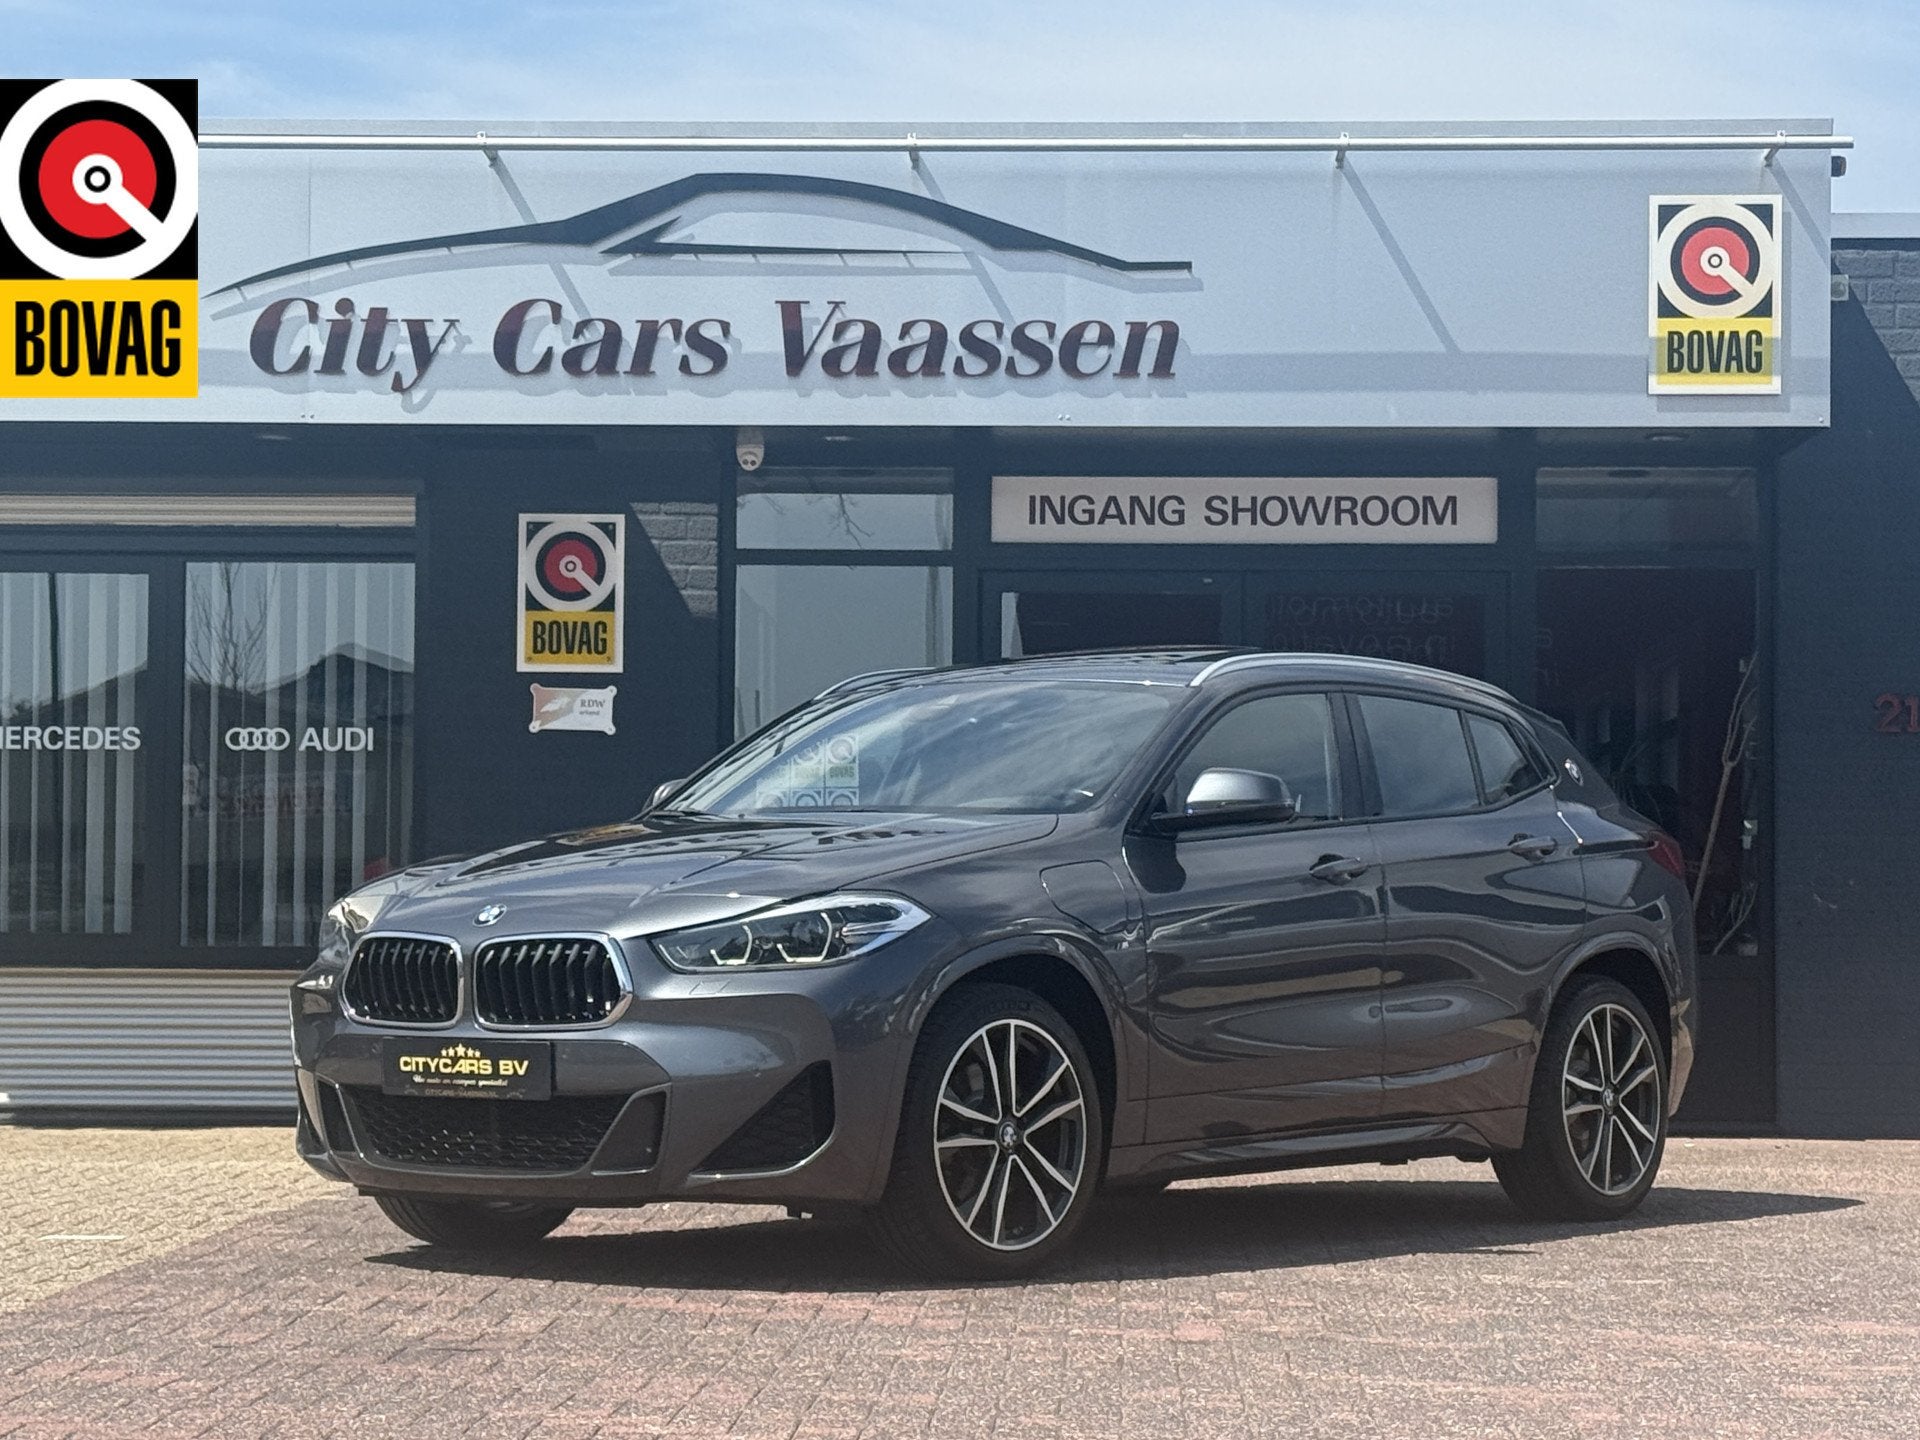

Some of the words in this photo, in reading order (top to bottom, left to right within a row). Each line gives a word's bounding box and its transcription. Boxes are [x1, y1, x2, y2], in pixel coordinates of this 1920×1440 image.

[249, 297, 460, 393] City
[493, 297, 731, 378] Cars
[775, 300, 1180, 379] Vaassen
[1667, 329, 1763, 374] BOVAG
[1028, 494, 1187, 527] INGANG
[1204, 494, 1458, 527] SHOWROOM
[532, 621, 608, 656] BOVAG
[580, 699, 606, 708] RDW
[0, 726, 142, 750] ERCEDES
[299, 727, 374, 752] AUDI
[399, 1056, 493, 1075] CITYCARS
[499, 1060, 529, 1076] BV
